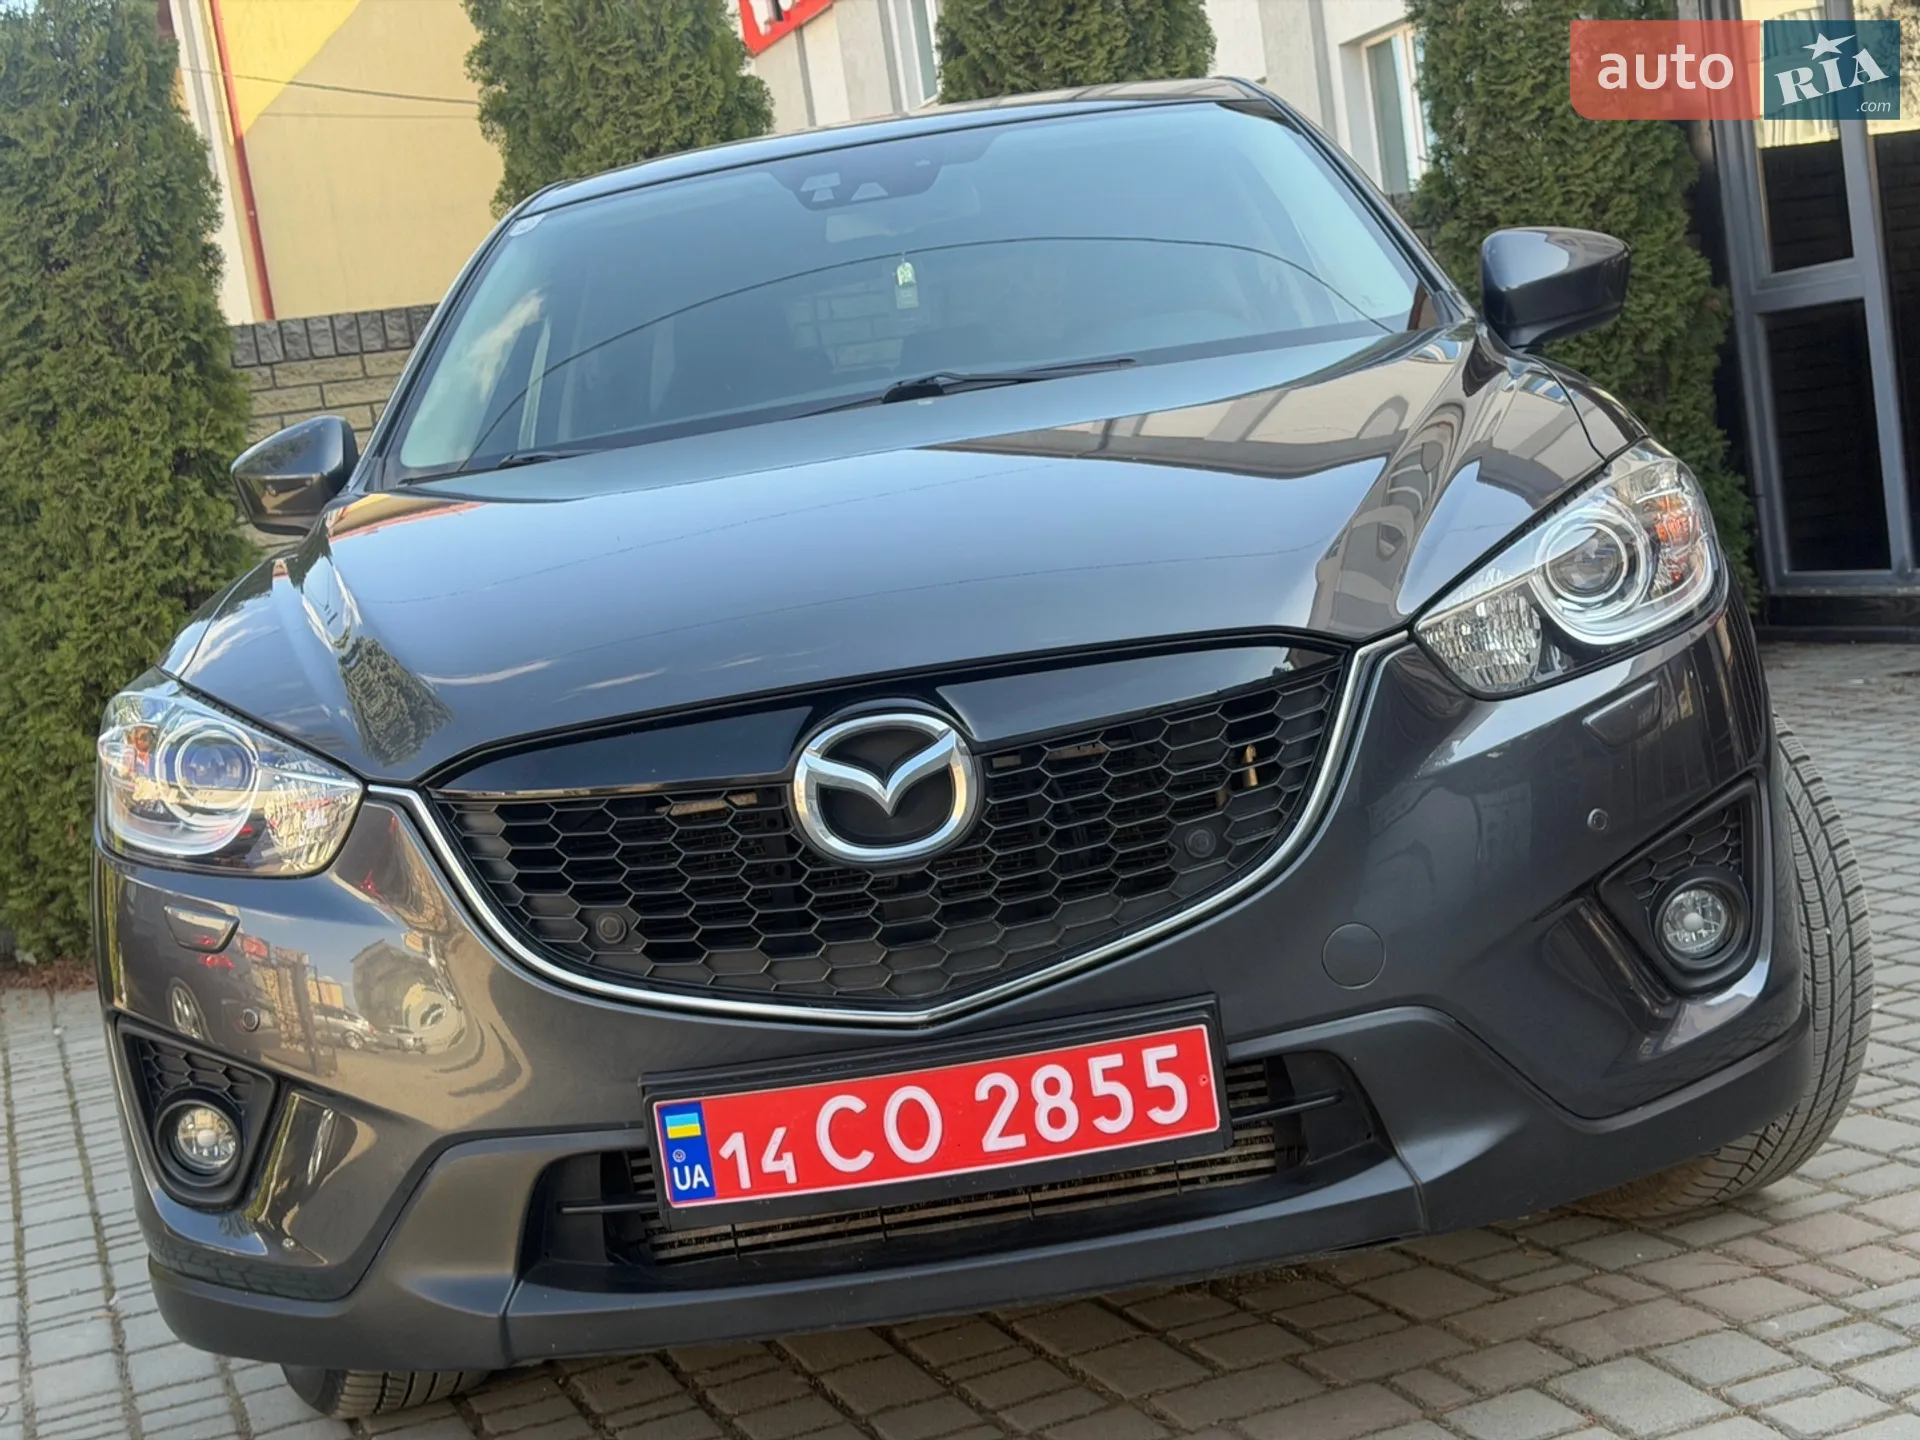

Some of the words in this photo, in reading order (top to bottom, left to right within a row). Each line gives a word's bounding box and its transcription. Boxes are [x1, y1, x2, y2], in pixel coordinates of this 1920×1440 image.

[718, 1125, 799, 1190] 14
[815, 1084, 943, 1173] CO
[974, 1043, 1189, 1153] 2855
[673, 1164, 710, 1191] UA
